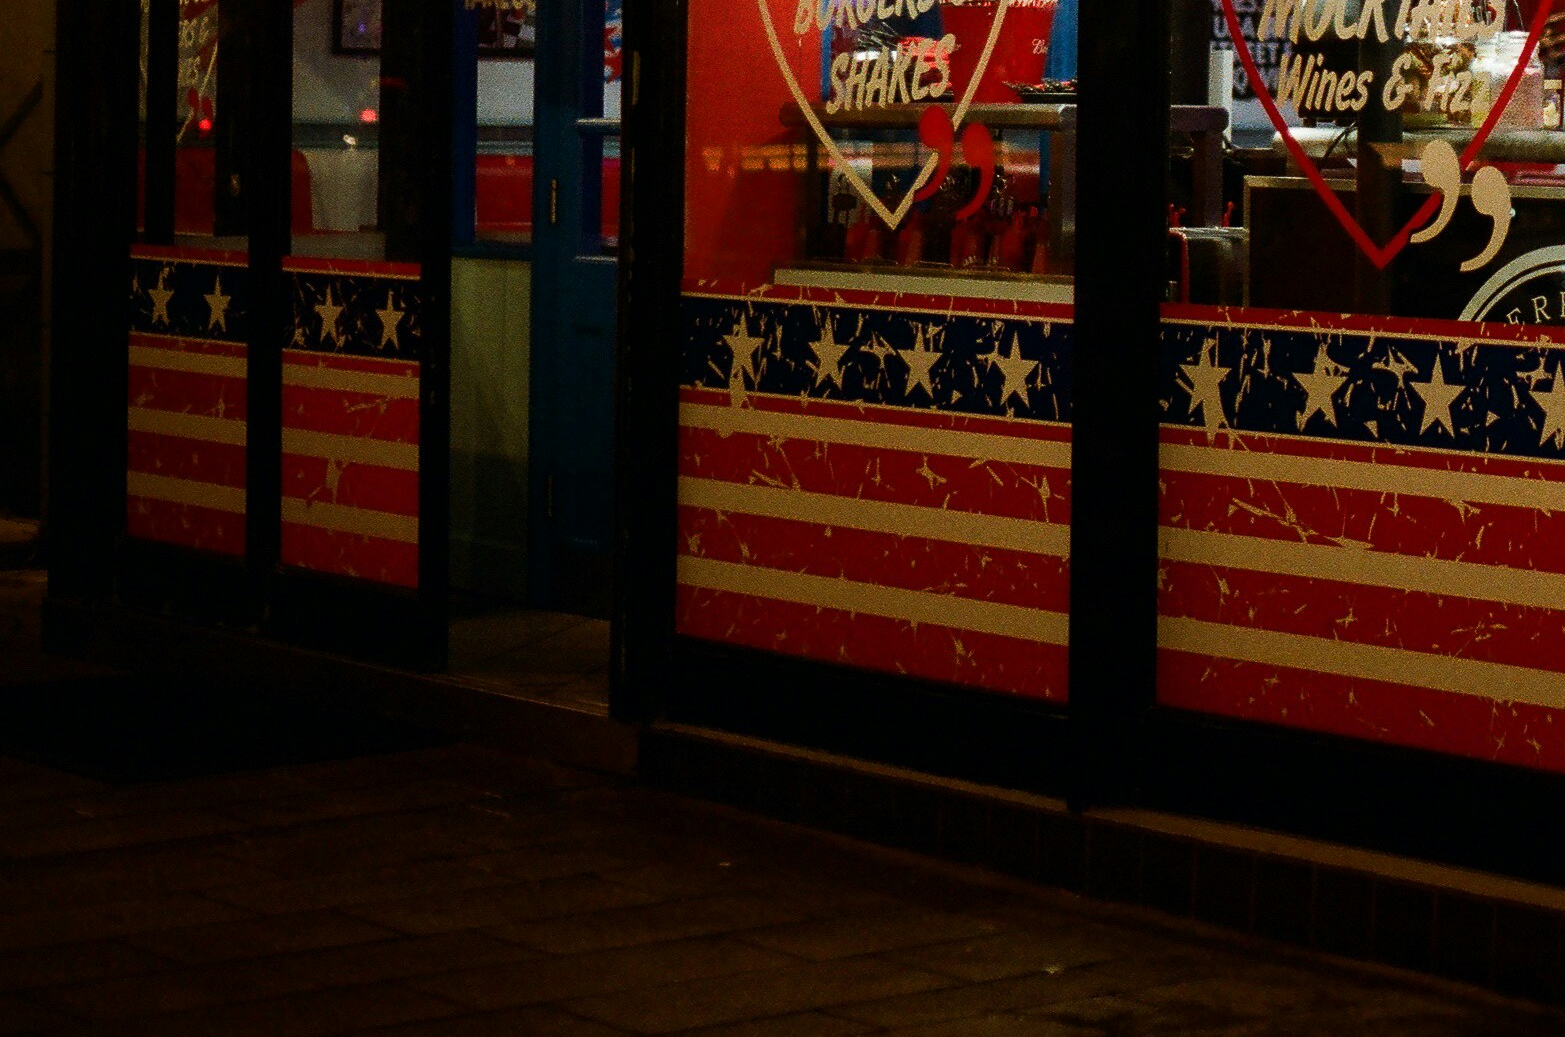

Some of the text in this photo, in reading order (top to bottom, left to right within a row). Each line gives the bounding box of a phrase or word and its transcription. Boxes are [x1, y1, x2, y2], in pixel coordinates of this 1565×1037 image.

[825, 33, 957, 116] SHAKES
[1276, 52, 1374, 112] Wines
[1382, 50, 1415, 111] &
